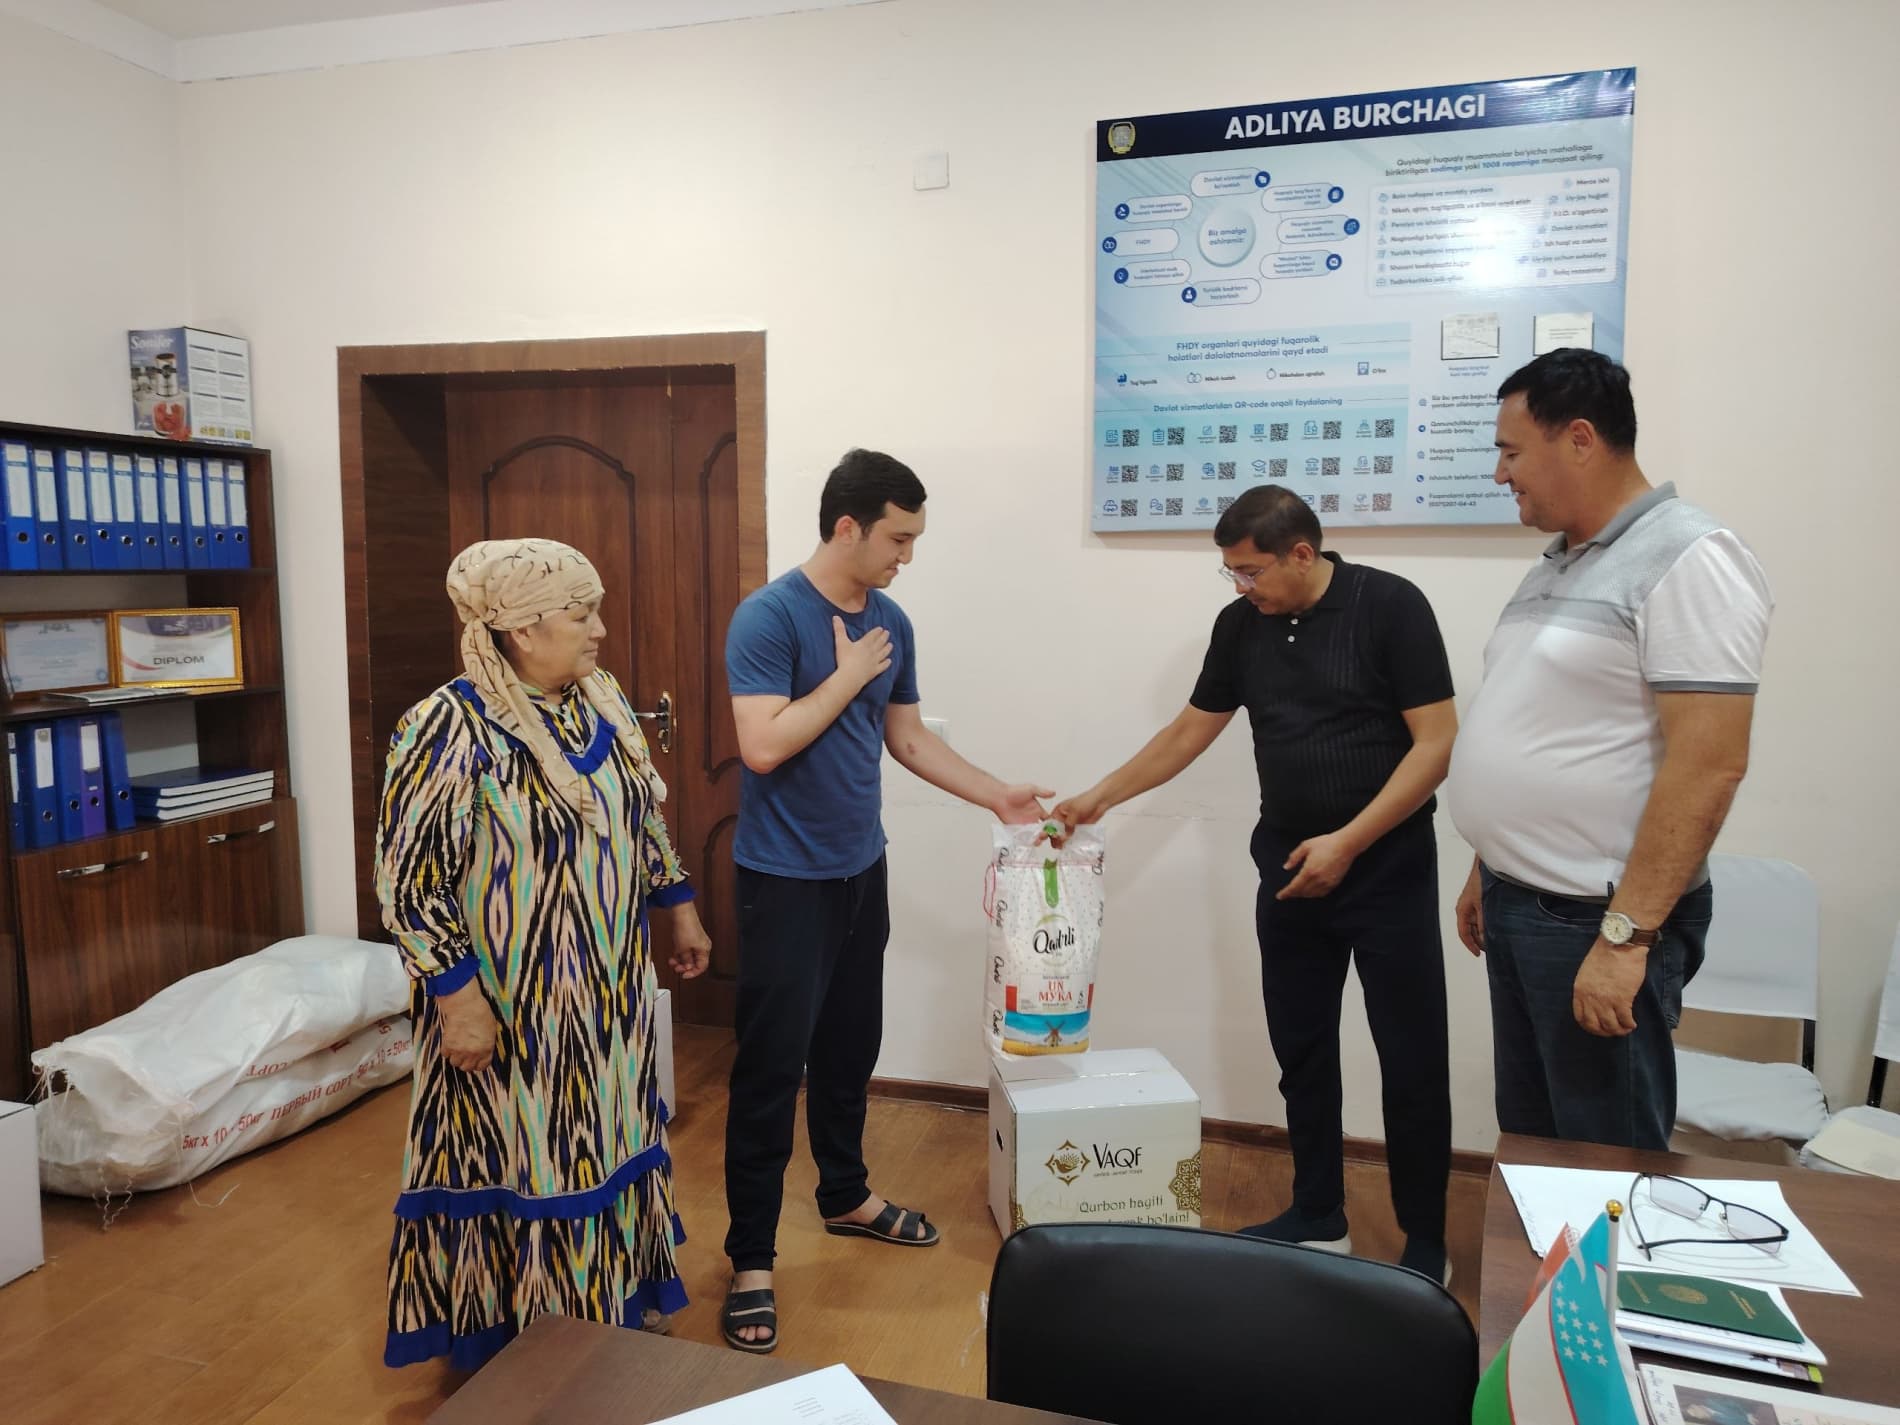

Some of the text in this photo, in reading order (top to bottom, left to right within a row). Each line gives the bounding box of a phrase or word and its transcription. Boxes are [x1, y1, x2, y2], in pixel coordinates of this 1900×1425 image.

[1225, 94, 1486, 139] ADLIYA BURCHAGI
[1176, 335, 1320, 350] FHDY organlari quyidagi fuqarolik
[1168, 345, 1328, 362] holatlari dalolatnomalarini qayd etadi
[1154, 404, 1179, 412] Davlat
[1234, 401, 1269, 410] QR-code
[1270, 399, 1293, 408] orqali
[1295, 397, 1342, 407] foydalaning
[153, 656, 205, 665] DIPLOM
[1039, 991, 1072, 1002] МУКА
[214, 1127, 228, 1144] 10
[271, 1085, 322, 1121] ПЕРВЫЙ
[325, 1073, 354, 1096] СОРТ
[1079, 1200, 1126, 1213] Qurbon
